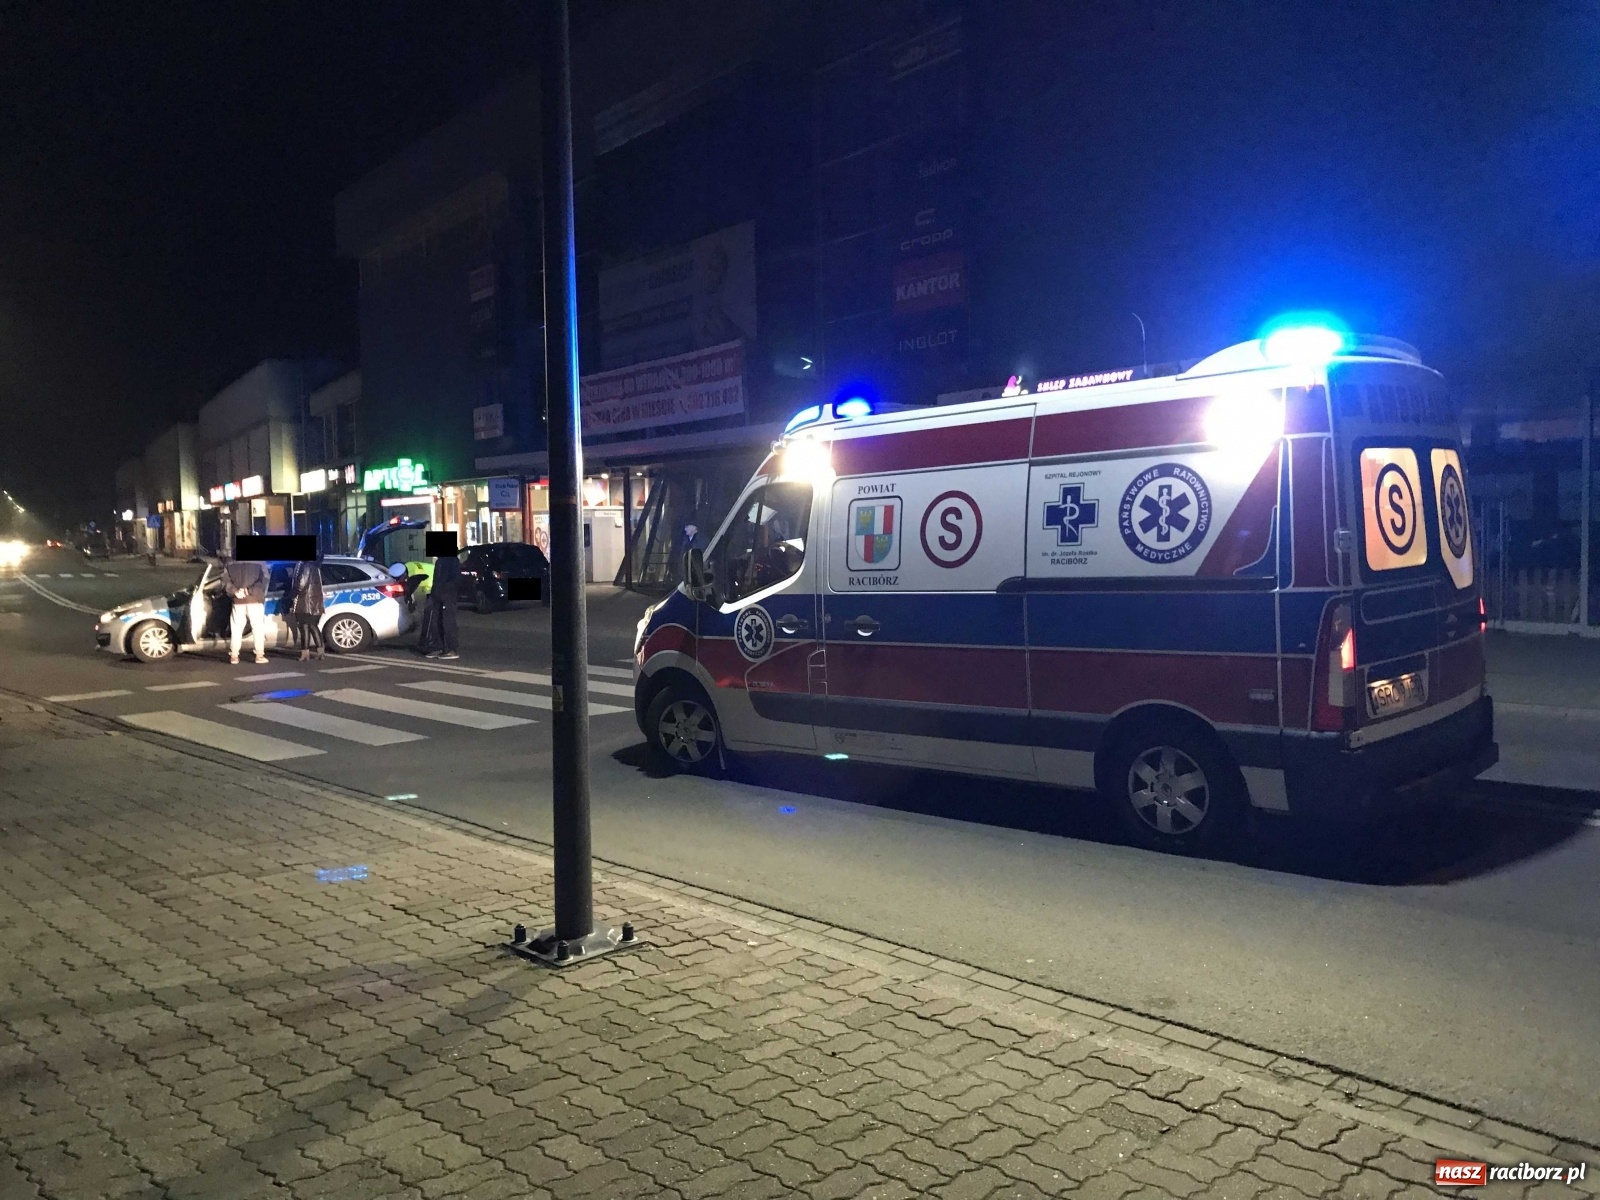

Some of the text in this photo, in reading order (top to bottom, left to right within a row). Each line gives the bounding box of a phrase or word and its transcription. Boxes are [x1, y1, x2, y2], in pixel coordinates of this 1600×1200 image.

[896, 272, 961, 302] KANTOR
[899, 329, 958, 352] INGLOT
[1069, 470, 1102, 478] REJONOWY
[858, 483, 896, 495] POWIAT
[1121, 467, 1209, 560] PAŃSTWOWE RATOWNICTWO MEDYCZNE
[1388, 484, 1406, 536] S
[938, 507, 963, 551] S
[1051, 556, 1088, 566] RACIBÓRZ
[848, 574, 899, 586] RACIBÓRZ
